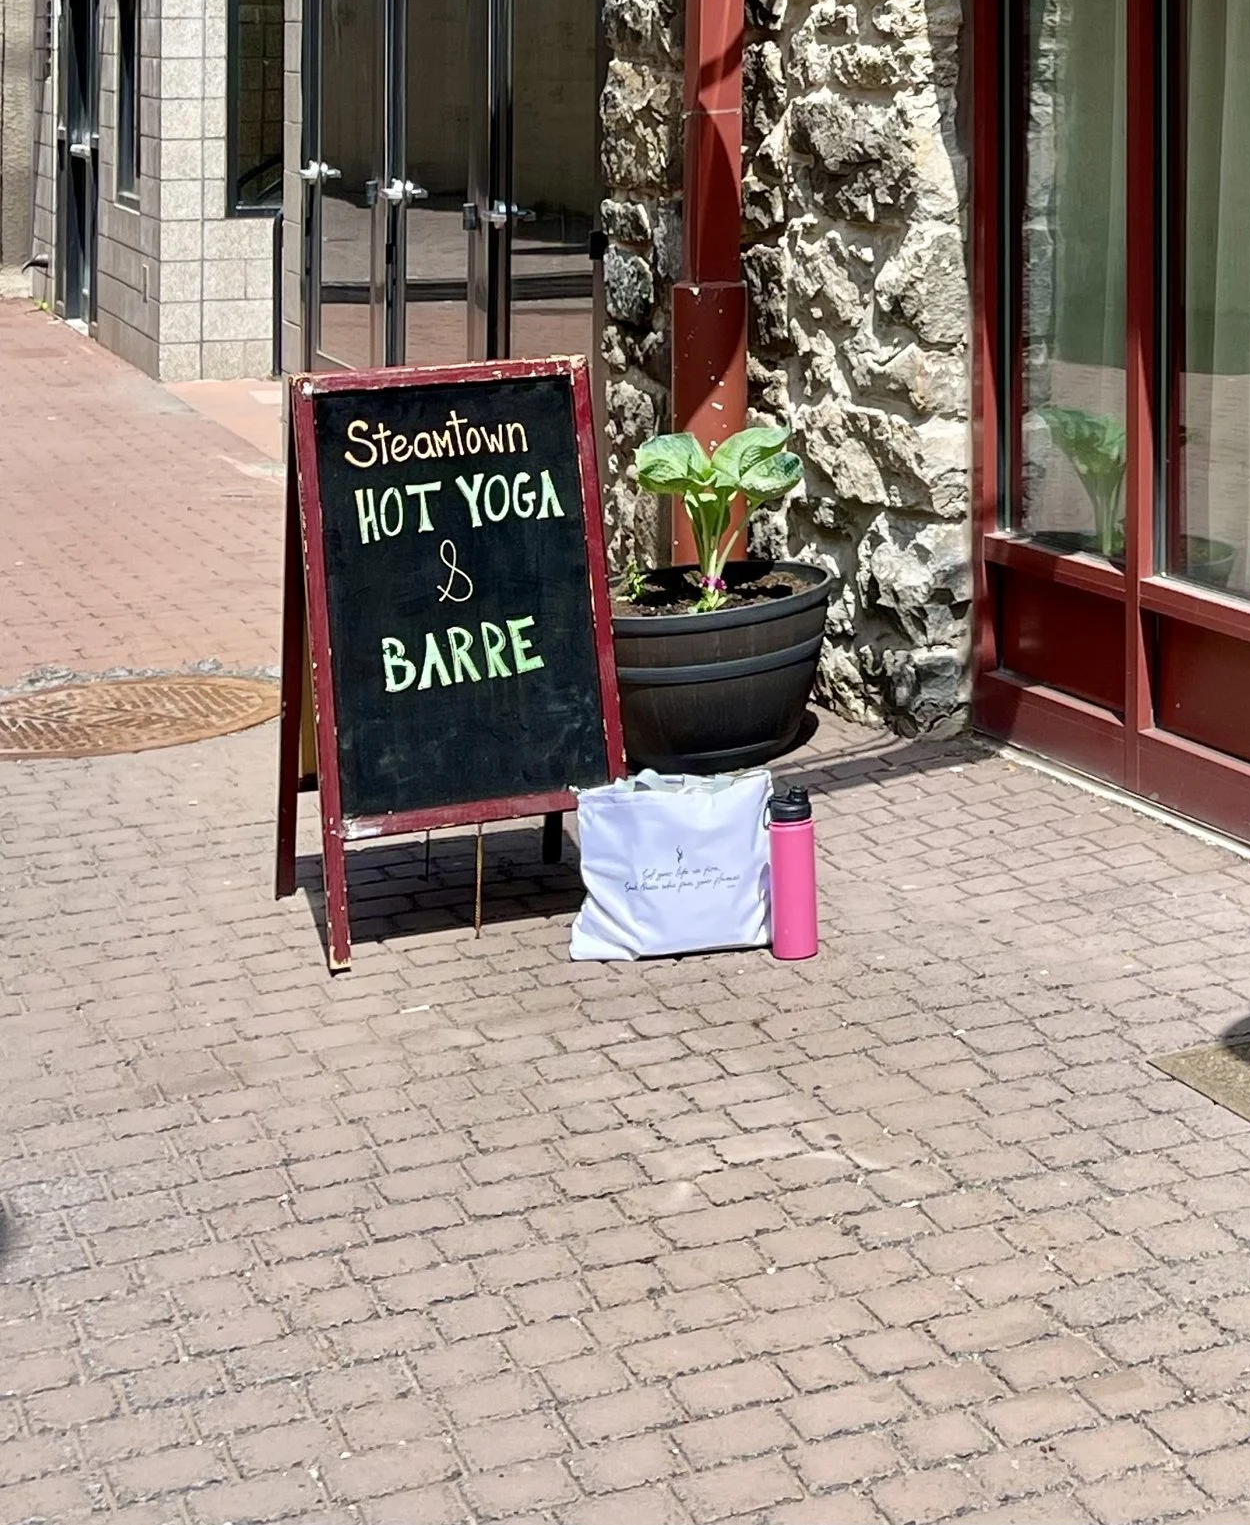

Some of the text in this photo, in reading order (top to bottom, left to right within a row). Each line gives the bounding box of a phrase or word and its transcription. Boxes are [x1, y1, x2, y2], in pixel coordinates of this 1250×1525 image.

[344, 410, 530, 468] Steamtown
[354, 469, 566, 545] HOT YOGA
[436, 539, 474, 603] &
[381, 615, 546, 693] BARRE
